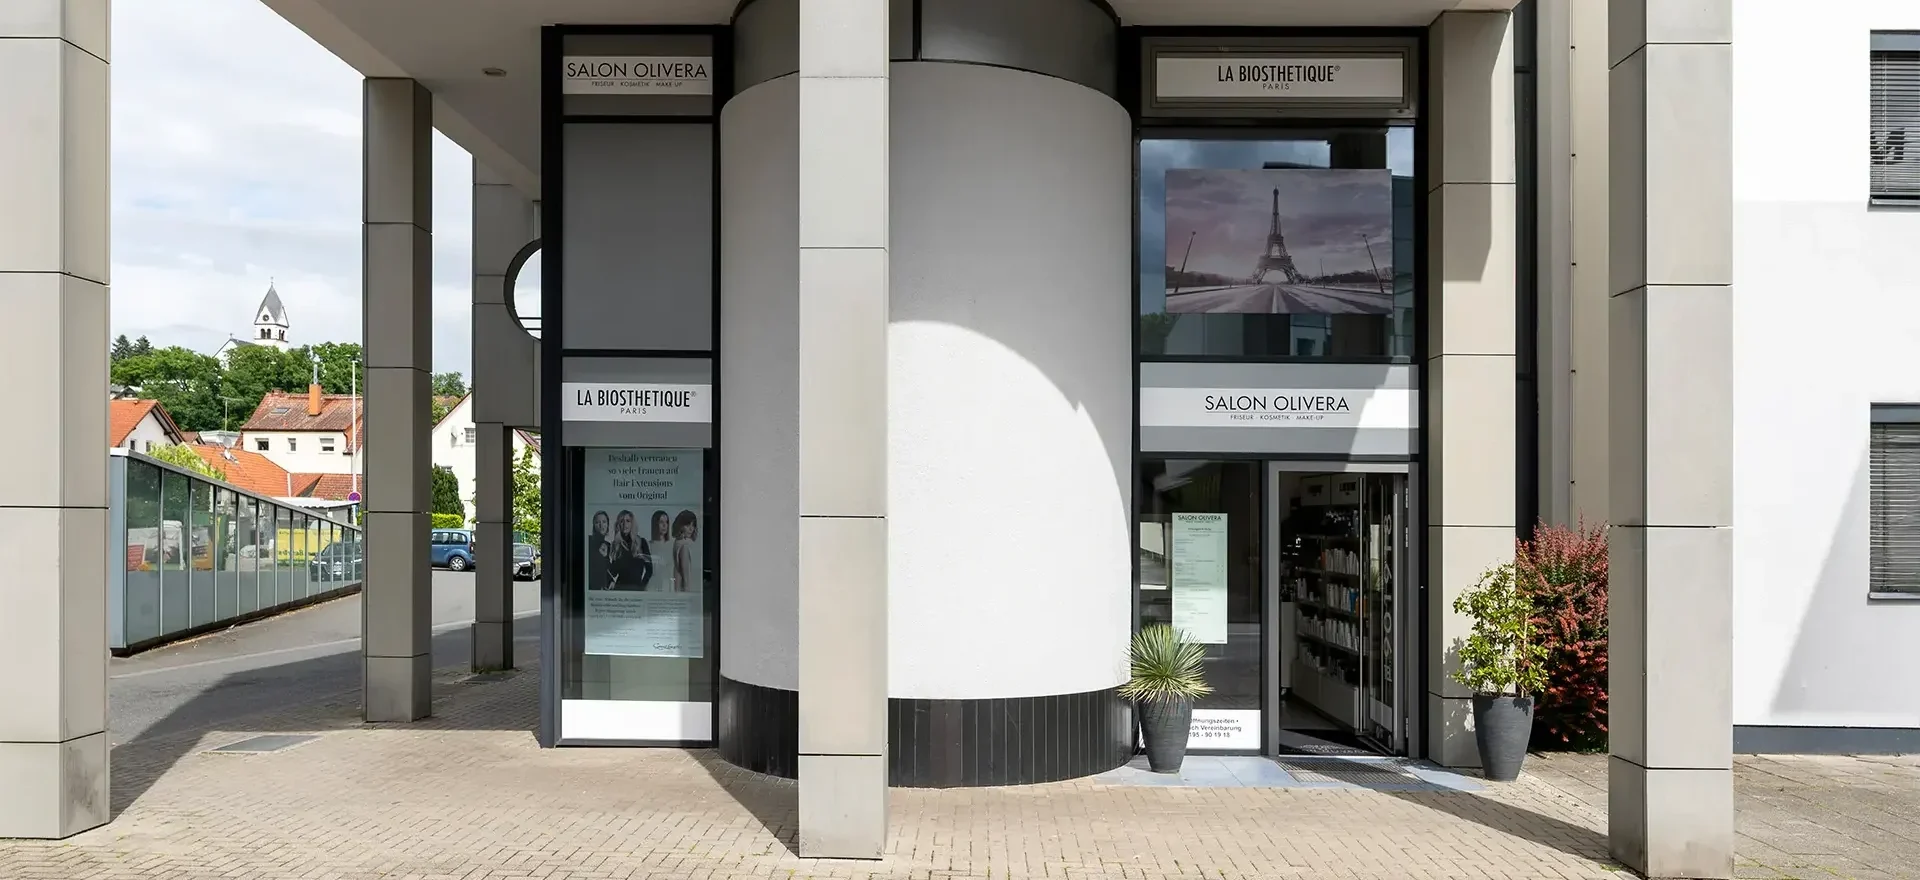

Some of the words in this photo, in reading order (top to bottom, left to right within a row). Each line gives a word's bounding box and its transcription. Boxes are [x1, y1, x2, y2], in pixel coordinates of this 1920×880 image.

[567, 62, 627, 78] SALON
[633, 62, 708, 78] OLIVERA
[1218, 65, 1234, 82] LA
[577, 389, 593, 406] LA
[1204, 395, 1267, 411] SALON
[1273, 395, 1350, 411] OLIVERA
[639, 455, 678, 463] vertrauen
[618, 466, 637, 475] viele
[638, 466, 665, 475] Frauen
[665, 465, 680, 475] auf
[613, 479, 629, 488] Hair
[631, 479, 673, 488] Extensions
[618, 492, 635, 500] vom
[636, 491, 668, 501] Original
